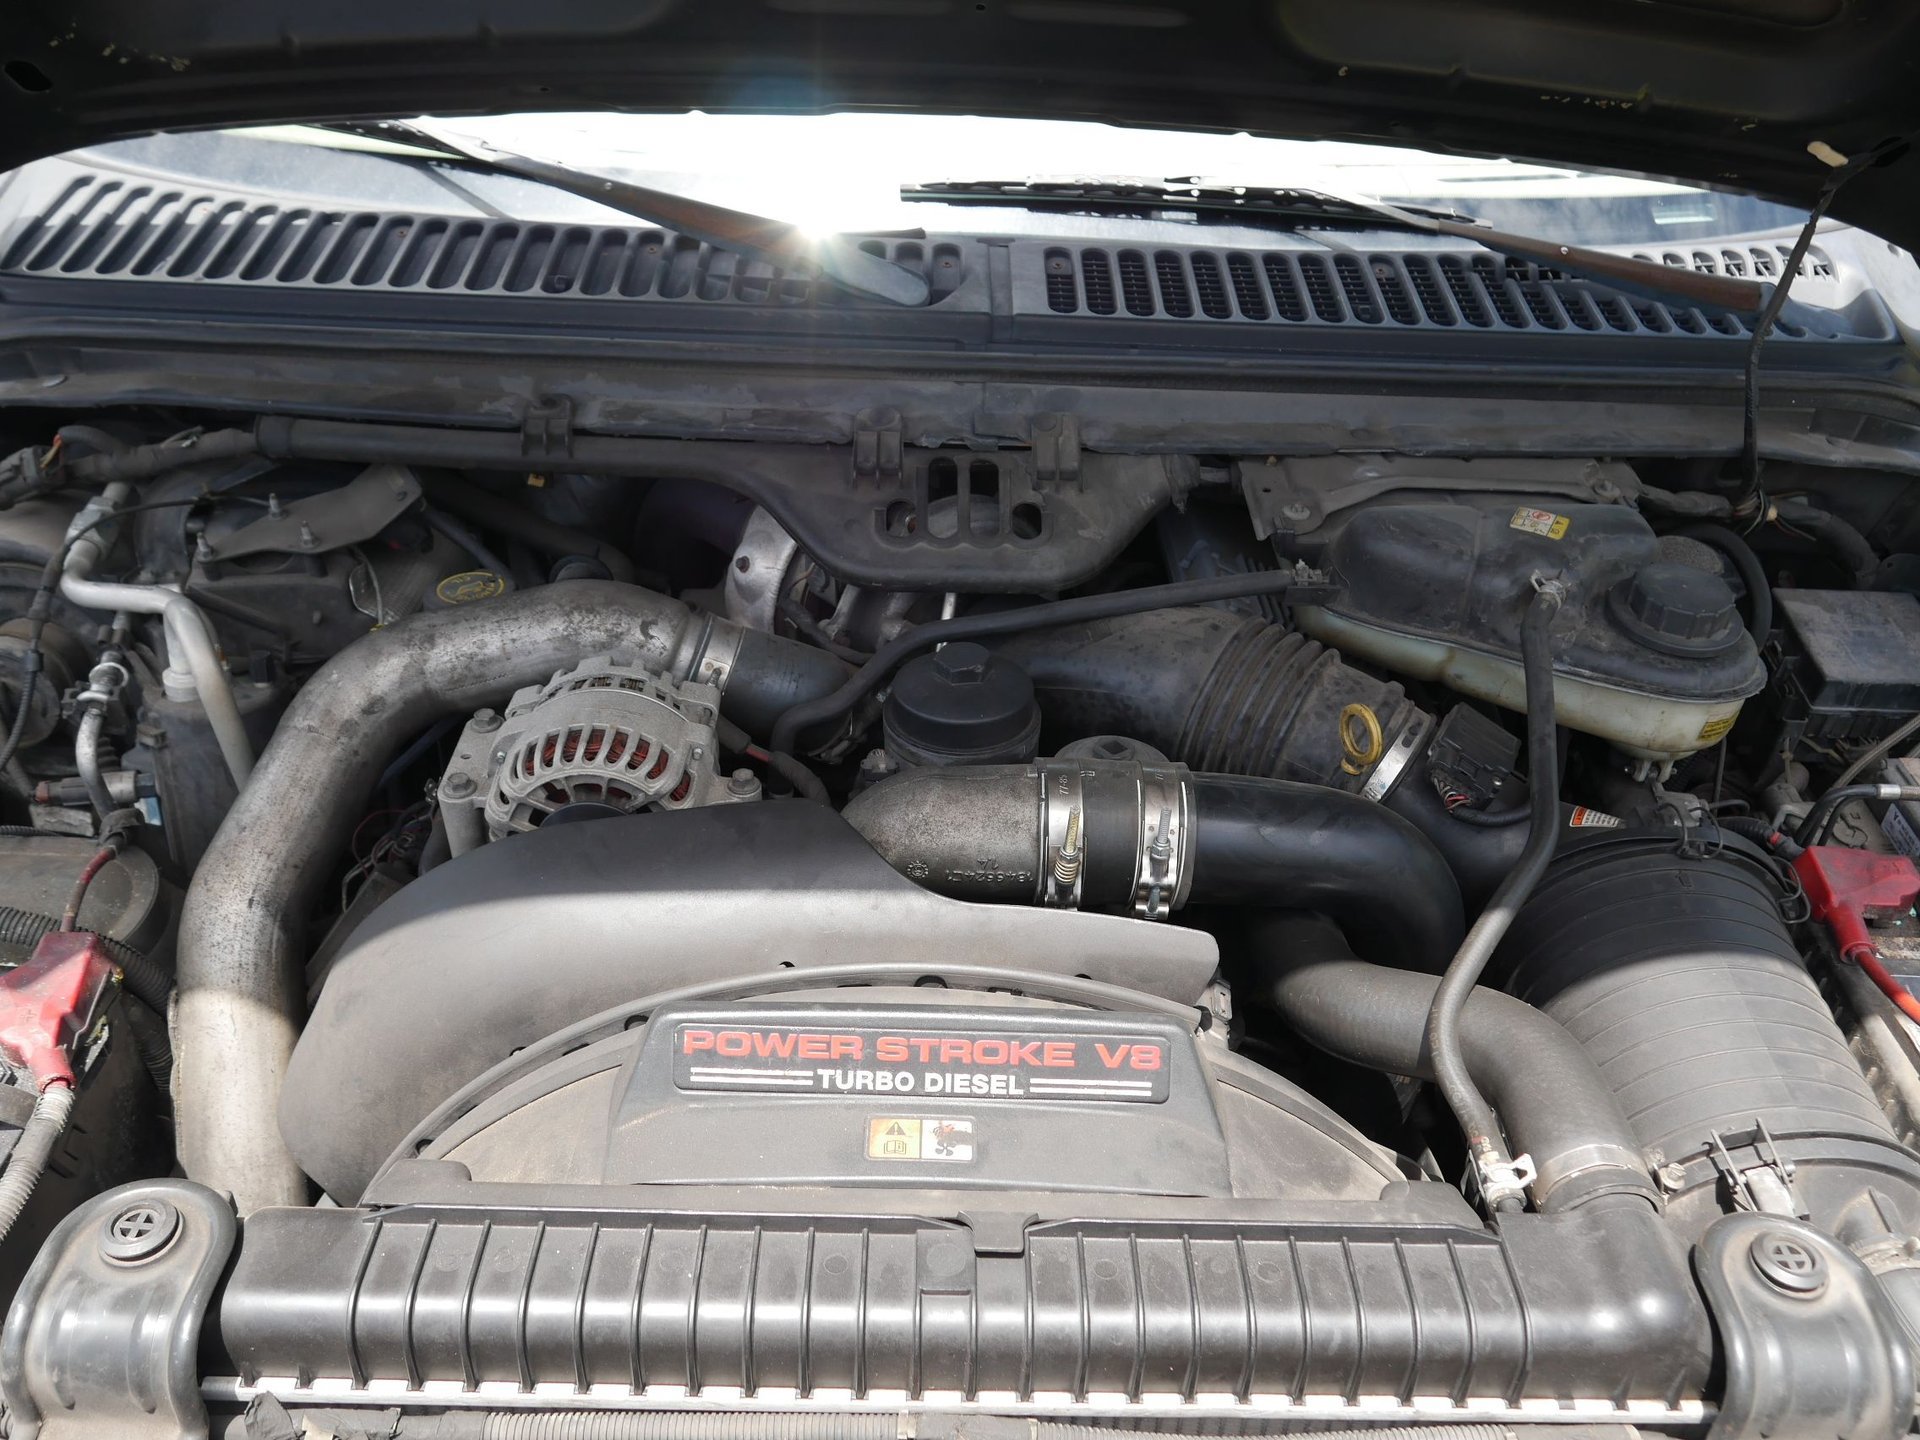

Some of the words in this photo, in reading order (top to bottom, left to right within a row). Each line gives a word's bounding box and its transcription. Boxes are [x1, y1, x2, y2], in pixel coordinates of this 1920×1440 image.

[683, 1029, 864, 1062] POWER
[875, 1036, 1077, 1068] STROKE
[1093, 1043, 1162, 1071] V8
[817, 1068, 915, 1092] TURBO
[924, 1072, 1024, 1096] DIESEL
